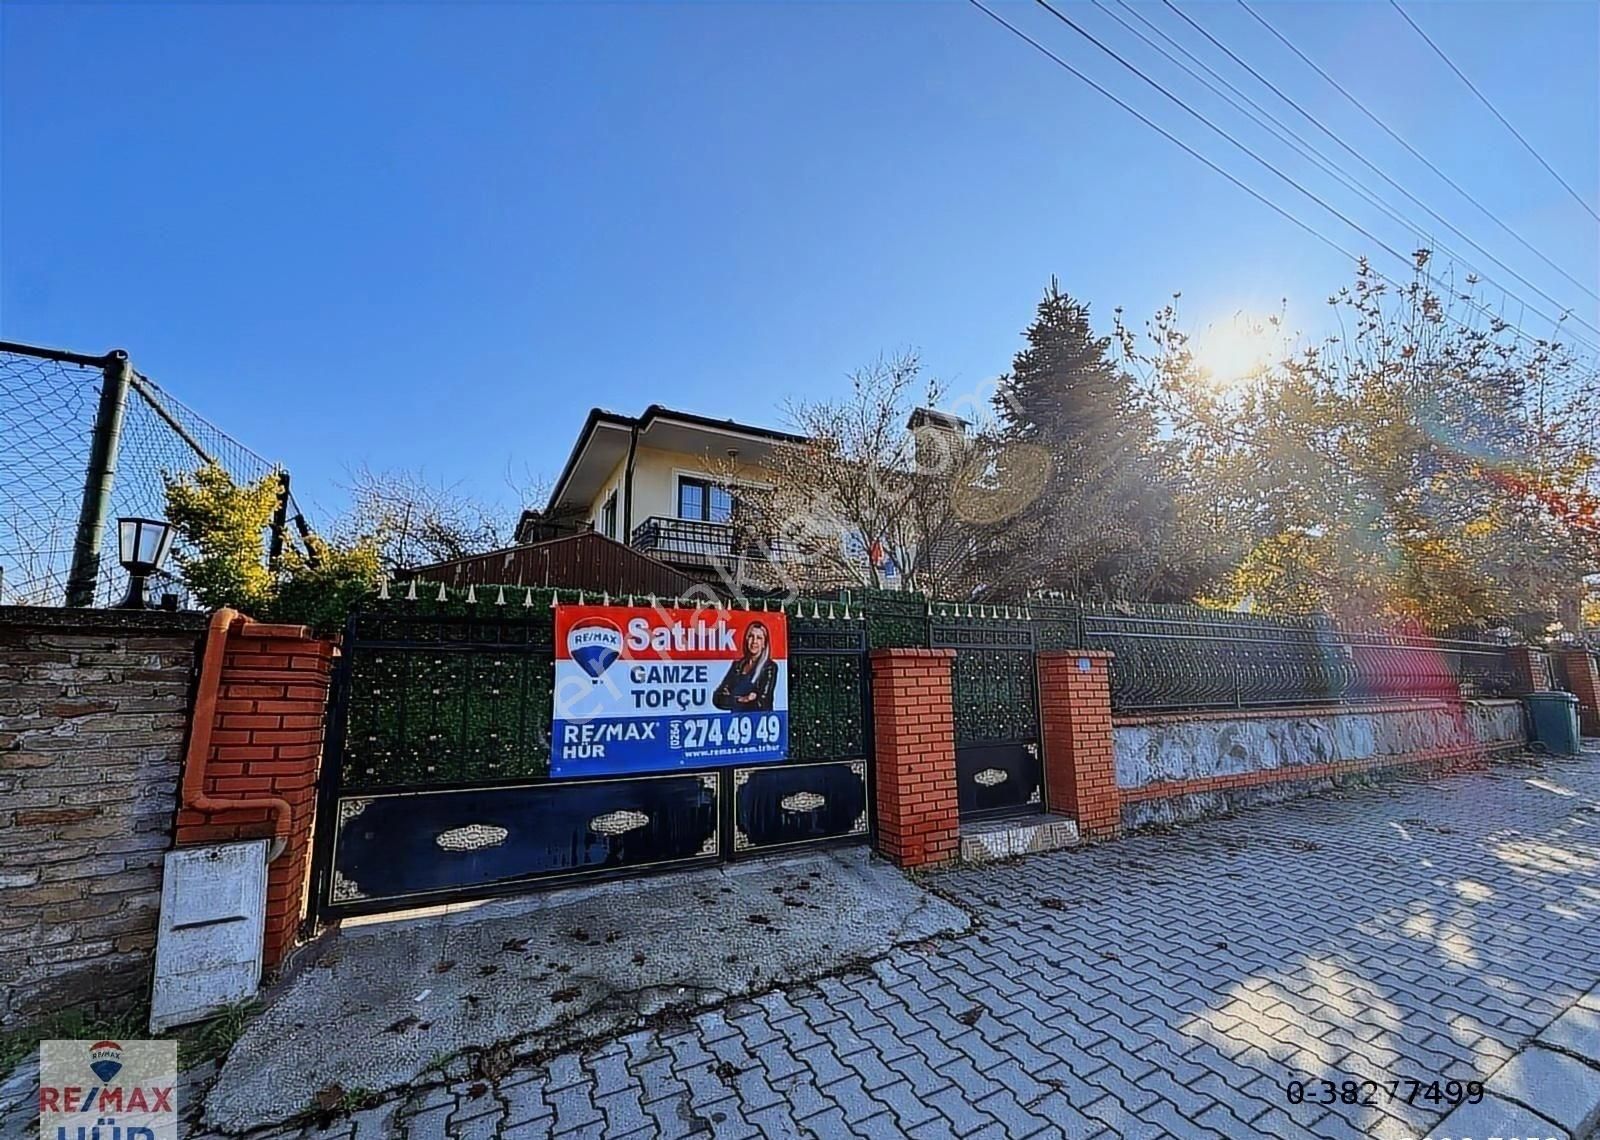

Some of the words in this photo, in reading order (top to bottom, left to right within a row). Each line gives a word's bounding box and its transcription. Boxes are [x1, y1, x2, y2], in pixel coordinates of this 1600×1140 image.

[574, 632, 617, 646] RE/MAX
[626, 617, 737, 652] Satılık
[630, 665, 708, 684] GAMZE
[630, 688, 706, 711] TOPÇU
[564, 722, 656, 743] RE/MAX
[684, 719, 723, 748] 274
[727, 716, 752, 745] 49
[756, 715, 780, 742] 49
[563, 739, 605, 759] HÜR
